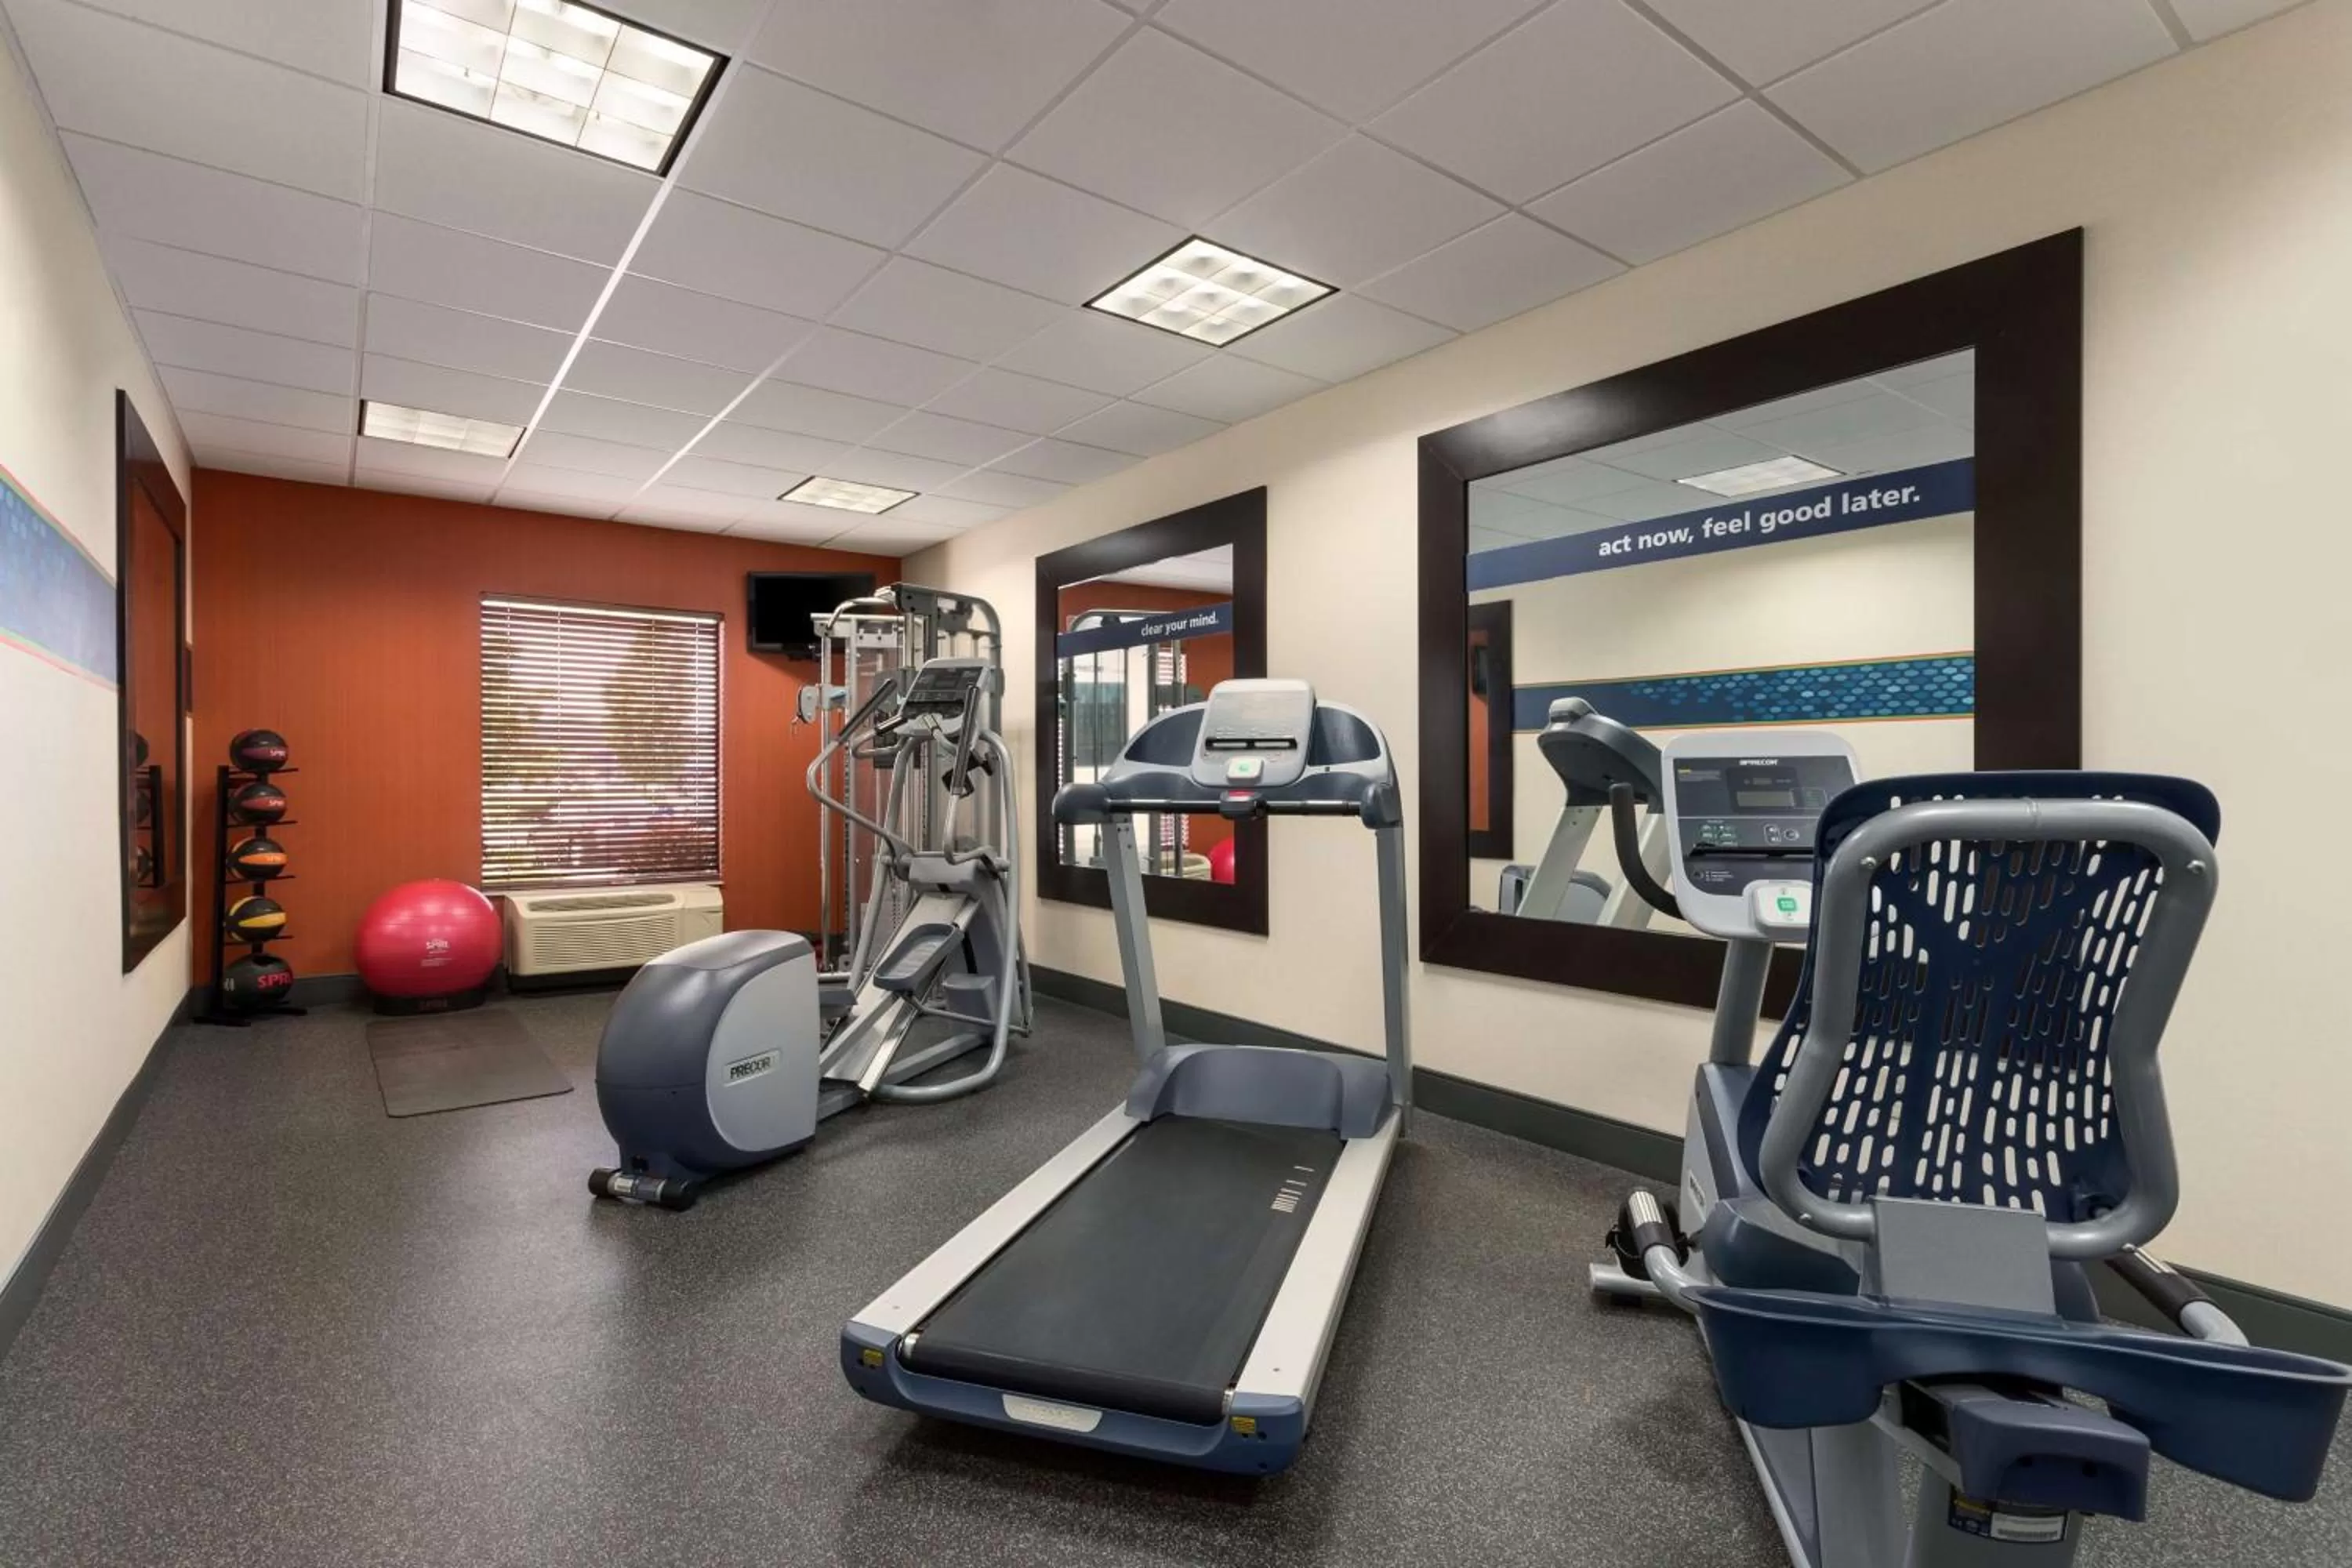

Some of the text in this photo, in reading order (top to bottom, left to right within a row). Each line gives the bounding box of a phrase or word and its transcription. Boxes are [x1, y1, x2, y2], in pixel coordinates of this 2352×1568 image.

[1598, 485, 1920, 557] act now, feel good later.
[1141, 611, 1219, 637] clear your mind.
[730, 1056, 770, 1080] PRECOR
